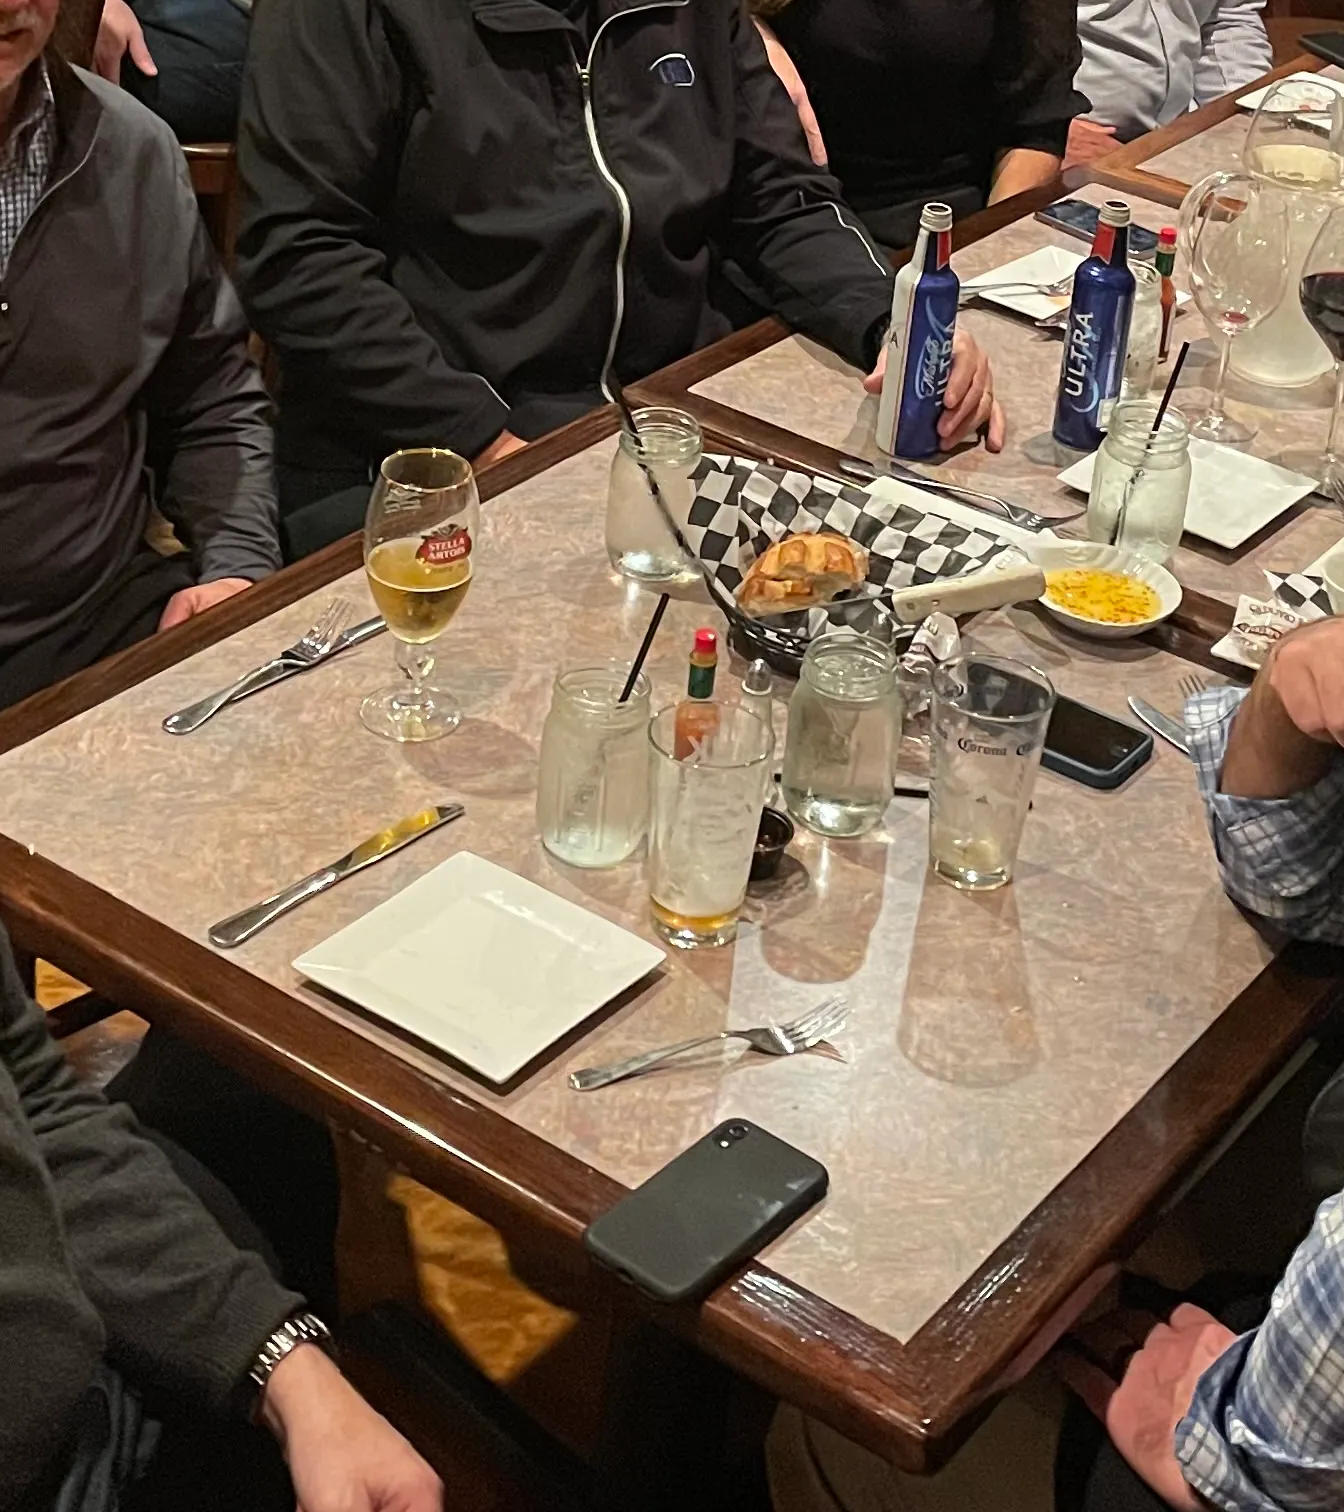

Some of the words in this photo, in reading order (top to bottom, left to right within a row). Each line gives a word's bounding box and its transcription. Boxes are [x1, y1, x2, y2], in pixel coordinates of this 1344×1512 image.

[1064, 311, 1095, 397] ULTRA
[428, 536, 465, 551] STELLA
[427, 546, 466, 560] ARTOIS
[957, 737, 1007, 756] Corona
